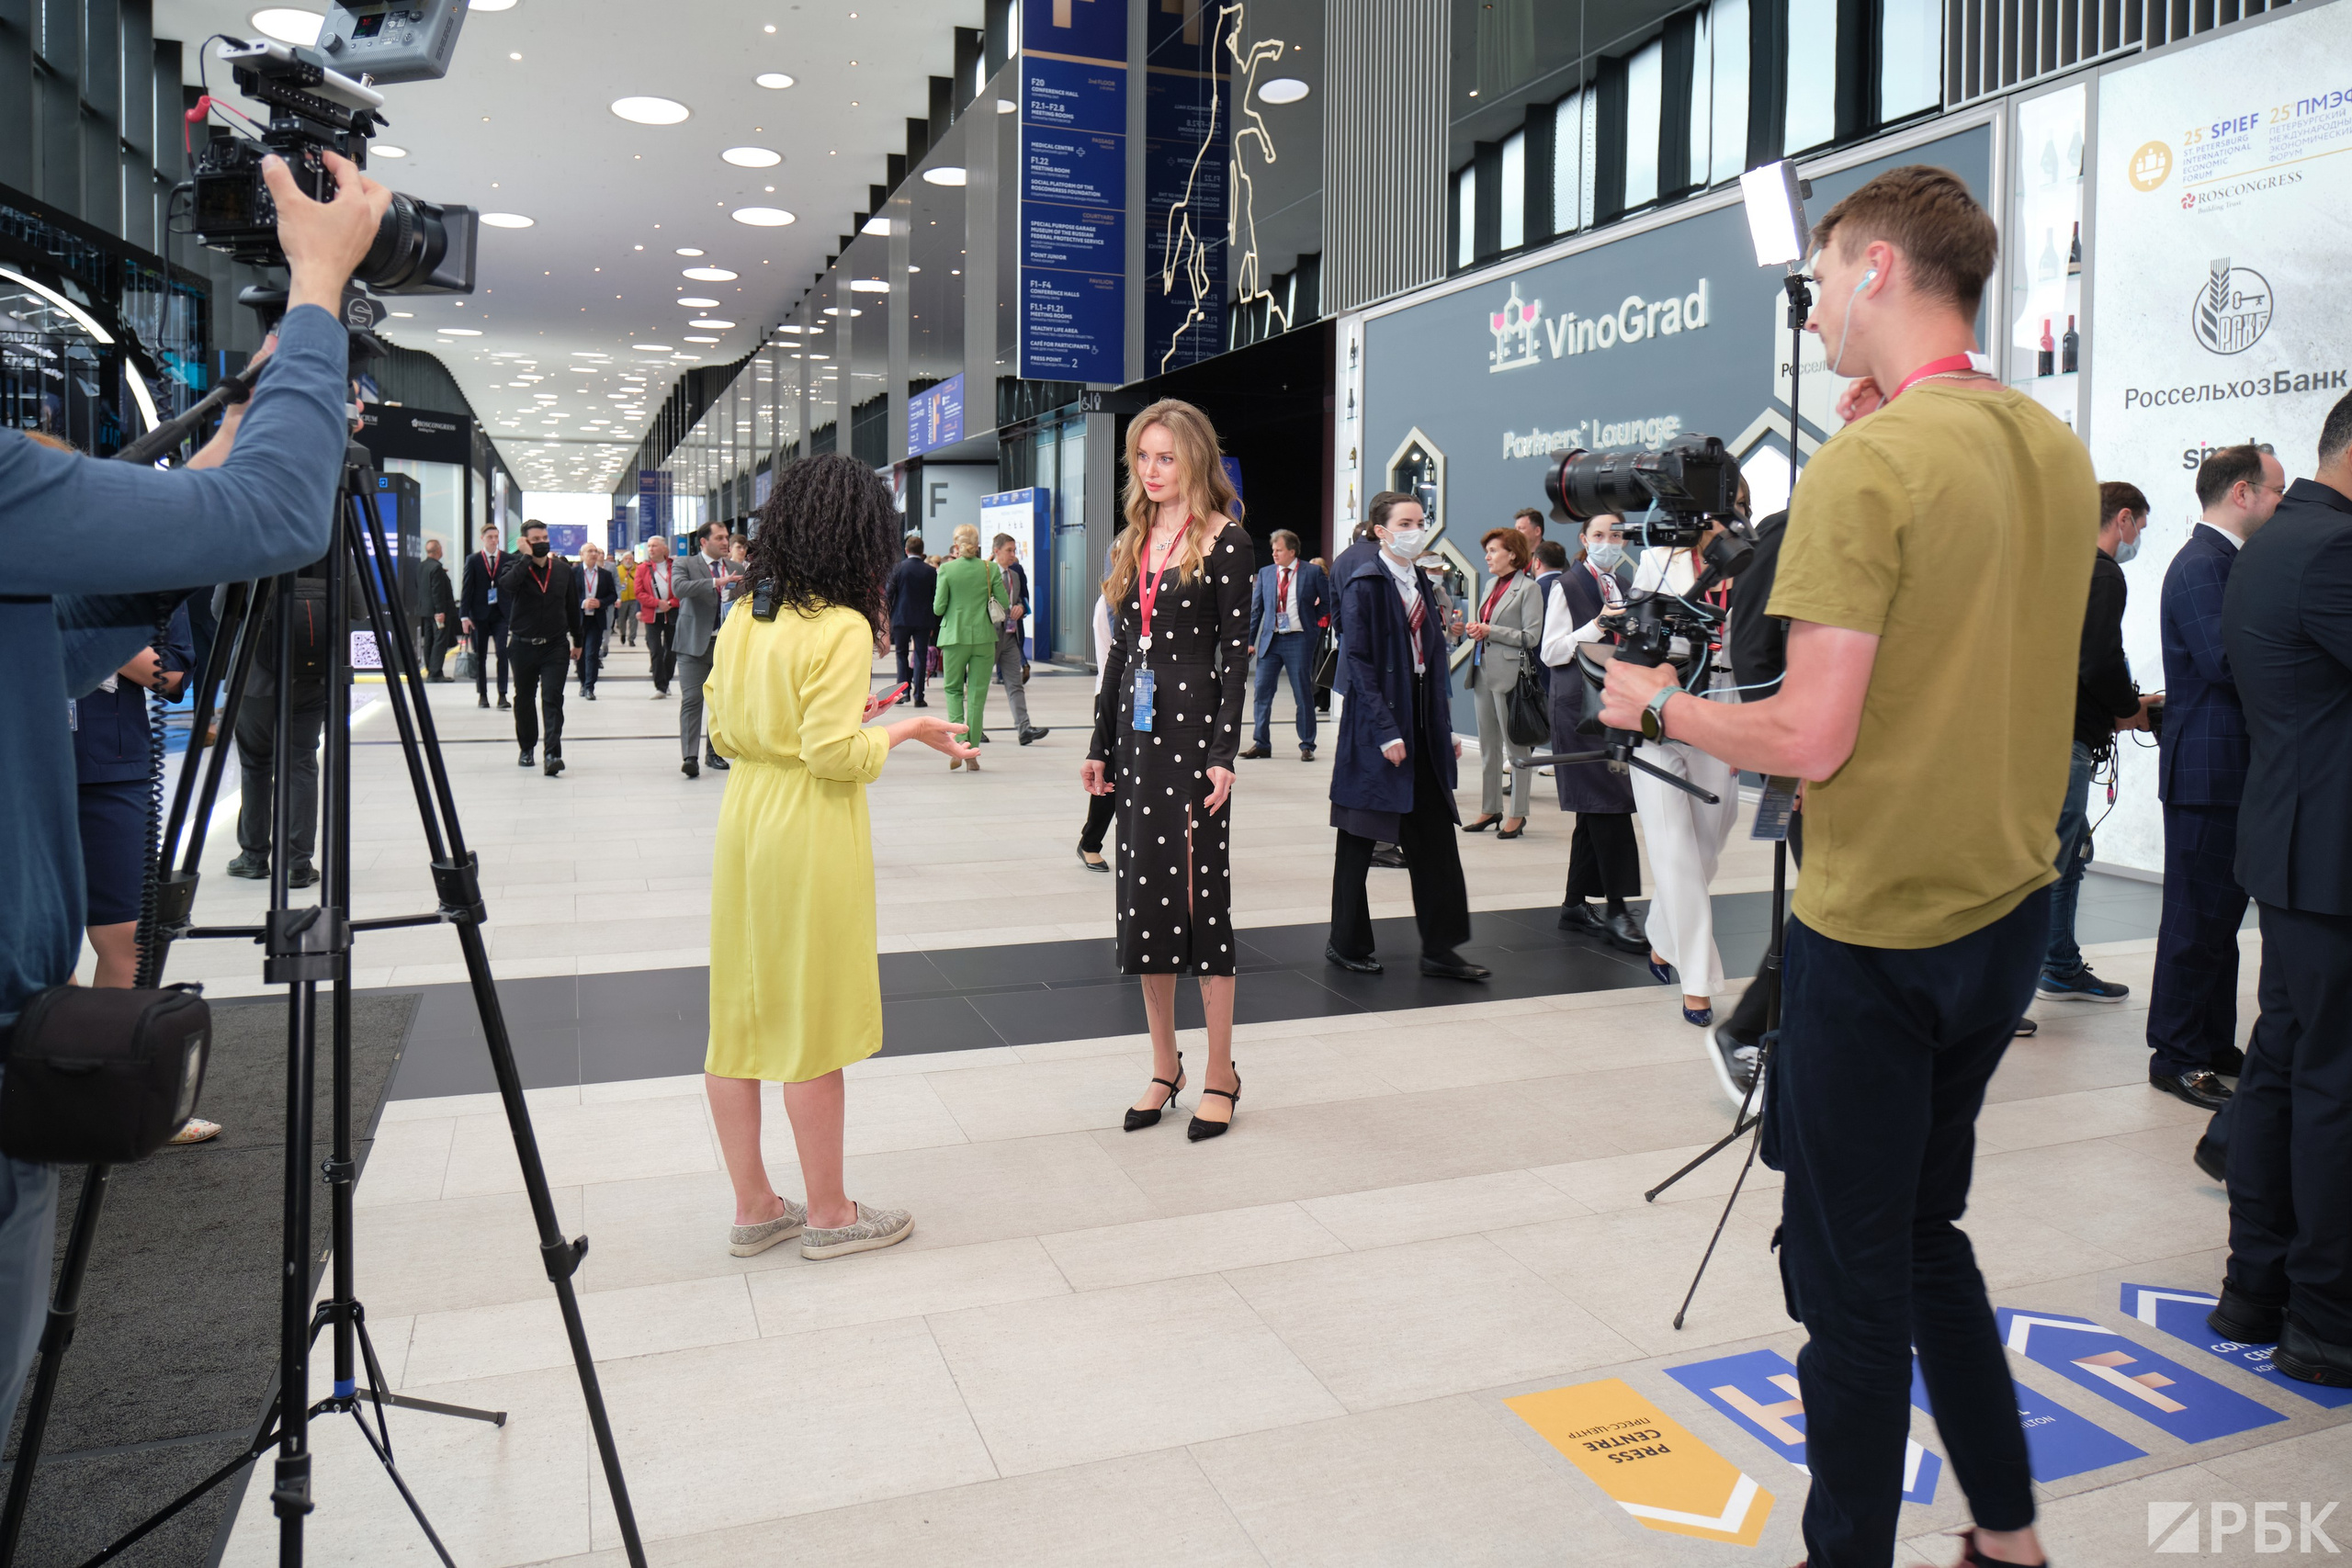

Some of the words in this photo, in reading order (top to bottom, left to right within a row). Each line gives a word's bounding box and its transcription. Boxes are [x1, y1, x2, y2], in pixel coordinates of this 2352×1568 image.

[1031, 78, 1046, 86] F20
[1031, 86, 1065, 96] CONFERENCE
[1031, 109, 1055, 118] MEETING
[2269, 107, 2346, 135] ПЕТЕРБУРГСКИЙ
[2211, 112, 2259, 139] SPIEF
[2269, 117, 2352, 144] МЕЖДУНАРОДНЫ
[1031, 141, 1054, 150] MEDICAL
[2183, 149, 2195, 157] ST.
[2196, 134, 2249, 154] PETERSBURG
[2269, 126, 2352, 153] ЭКОНОМИЧЕСКИ
[1031, 156, 1048, 165] F1.22
[2183, 142, 2252, 165] INTERNATIONAL
[2268, 148, 2302, 163] ФОРУМ
[2182, 170, 2212, 183] FORUM
[2183, 157, 2228, 175] ECONOMIC
[1031, 186, 1067, 194] ROSCONGRESS
[1068, 188, 1101, 197] FOUNDATION
[1049, 180, 1076, 188] PLATFORM
[2198, 170, 2303, 204] ROSCONGRESS
[2198, 204, 2224, 215] Building
[2225, 199, 2242, 209] Trust
[1053, 235, 1084, 243] PROTECTIVE
[1545, 277, 1709, 359] VinoGrad
[2124, 369, 2347, 410] РоссельхозБанк
[1592, 414, 1680, 451] Lounge
[930, 482, 948, 517] F
[1567, 1416, 1652, 1439] ПРЕСС-ЦЕНТР
[1582, 1429, 1662, 1451] CENTRE
[1607, 1443, 1672, 1463] PRESS
